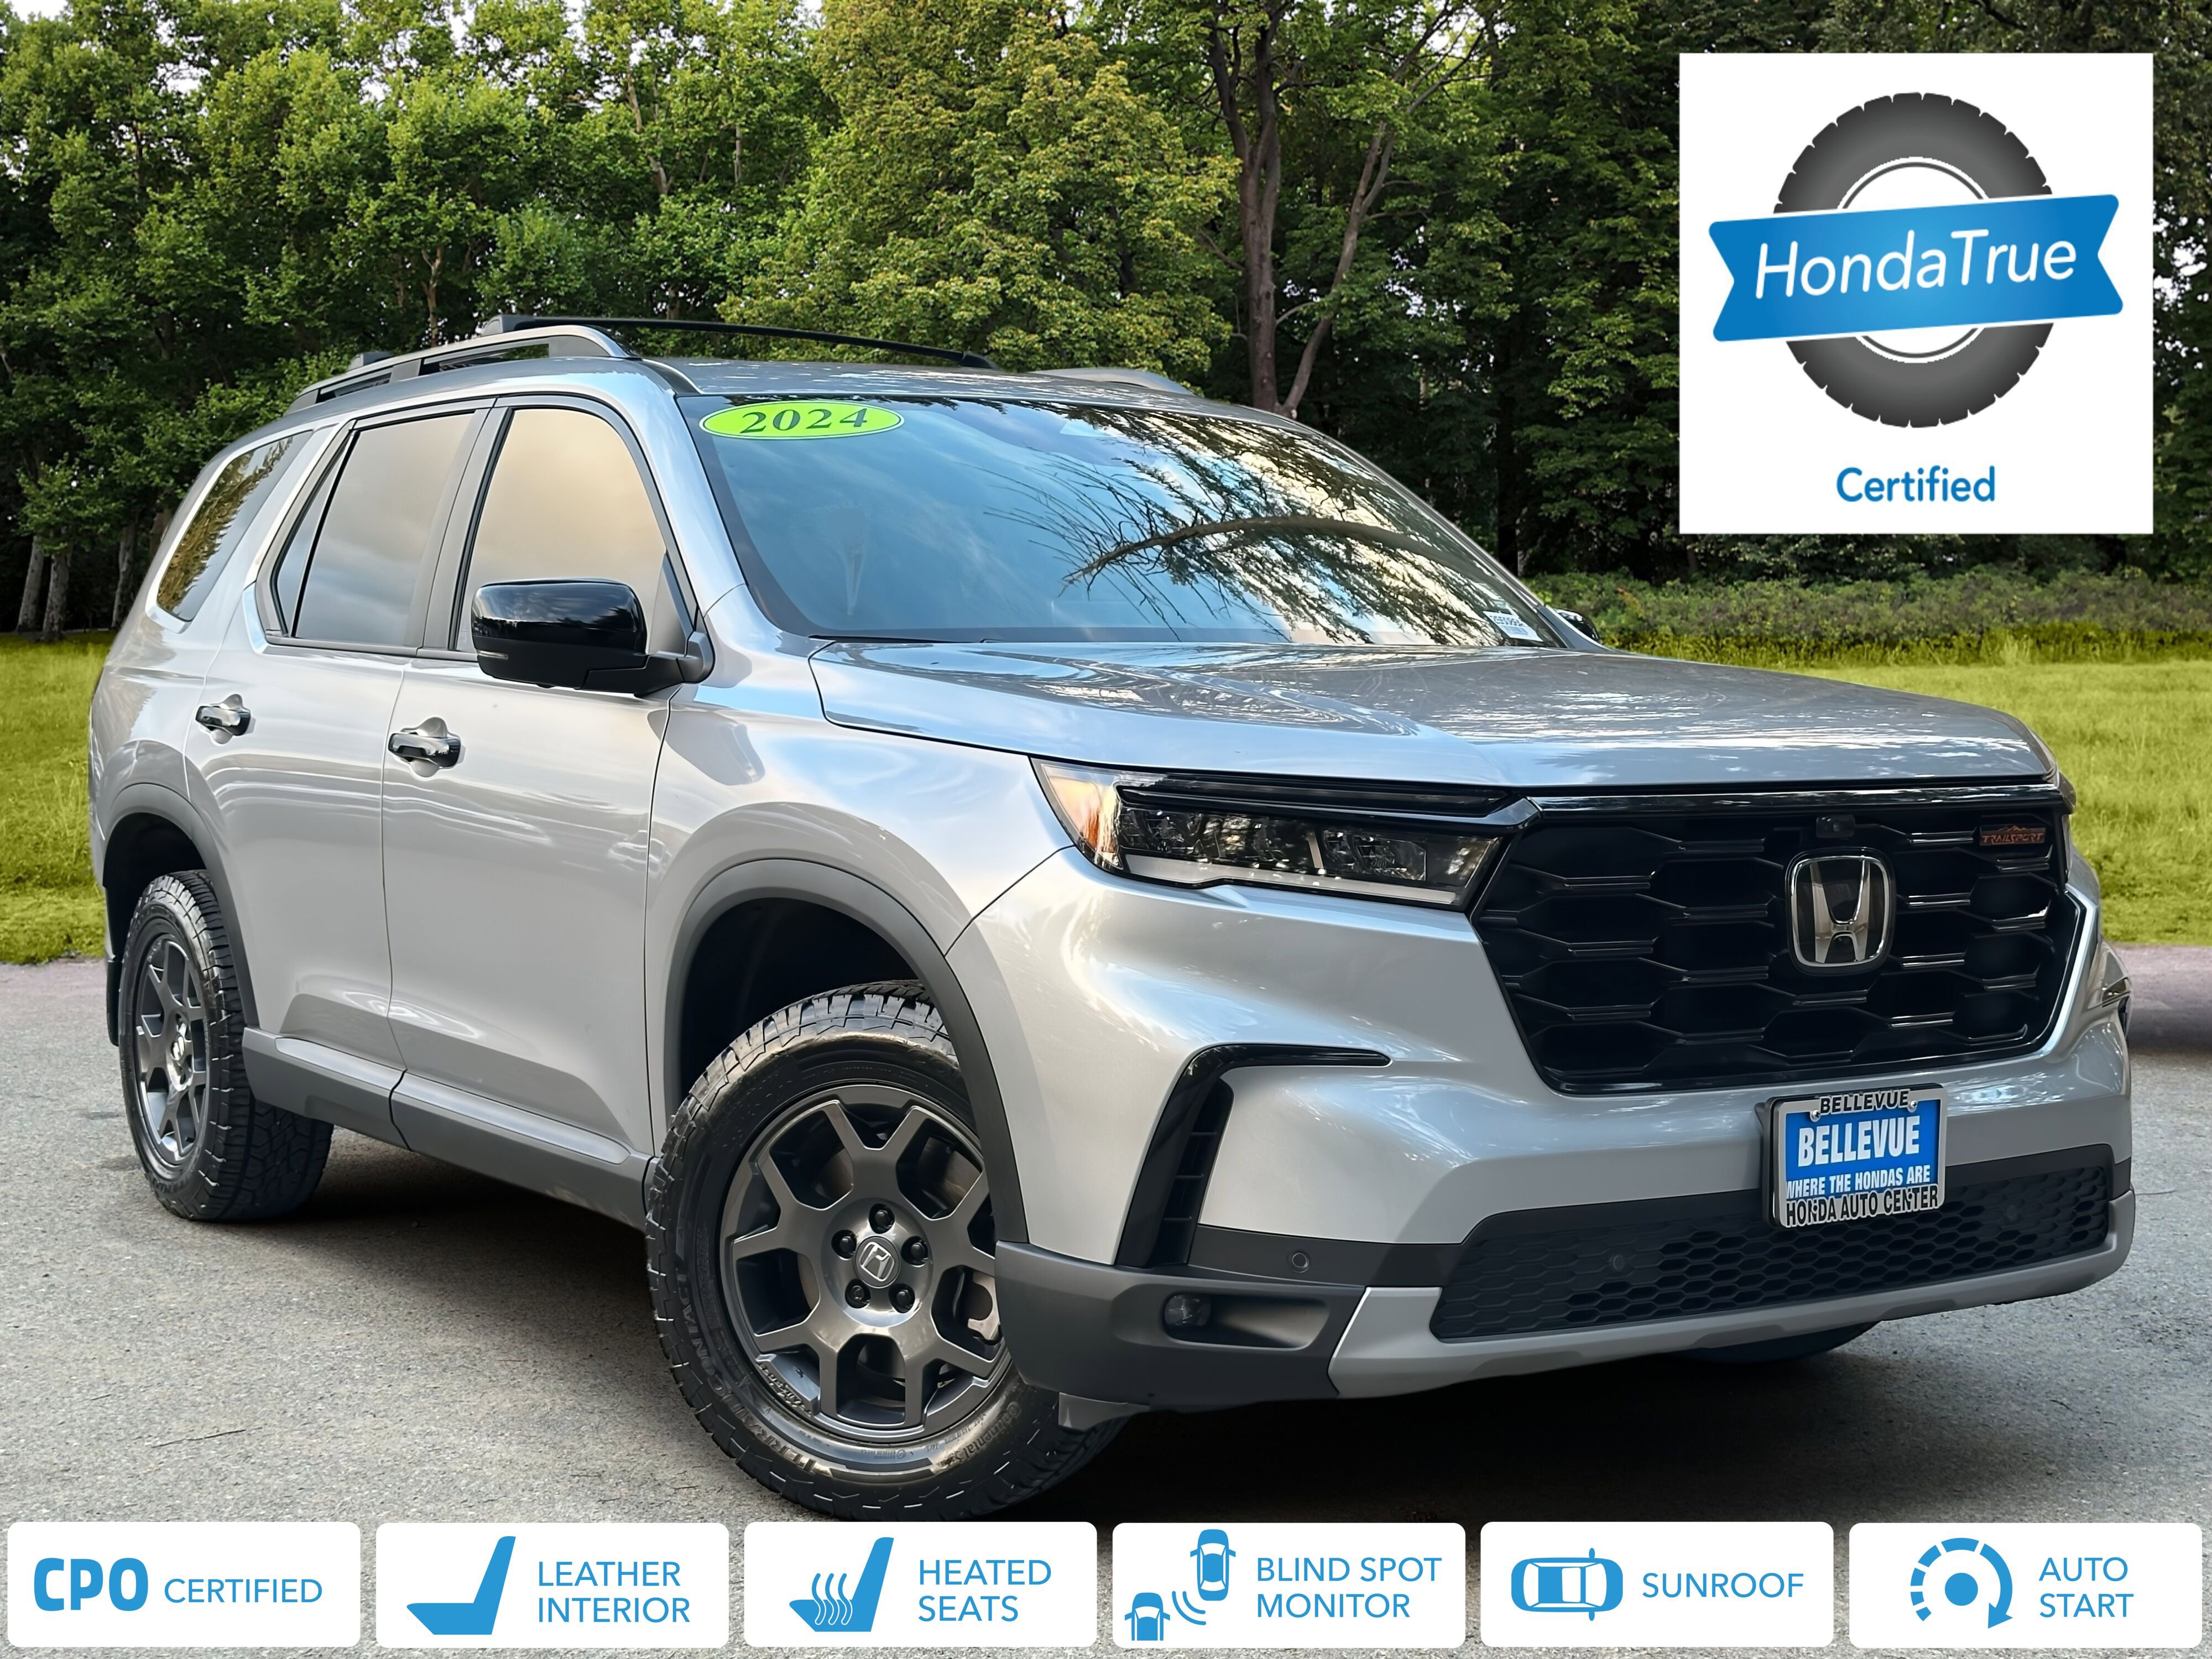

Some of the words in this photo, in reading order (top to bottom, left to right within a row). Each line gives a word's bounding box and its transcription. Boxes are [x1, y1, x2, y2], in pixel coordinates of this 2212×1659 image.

[740, 408, 868, 434] 2024
[1982, 833, 2044, 844] TRAILSPORT
[1819, 1090, 1909, 1114] BELLEVUE
[1798, 1115, 1920, 1167] BELLEVUE
[1786, 1177, 1825, 1199] WHERE
[1829, 1173, 1851, 1193] THE
[1855, 1169, 1903, 1191] HONDAS
[1906, 1165, 1931, 1185] ARE
[1786, 1197, 1838, 1227] HONDA
[1840, 1192, 1878, 1220] AUTO
[1883, 1185, 1938, 1215] CENTER
